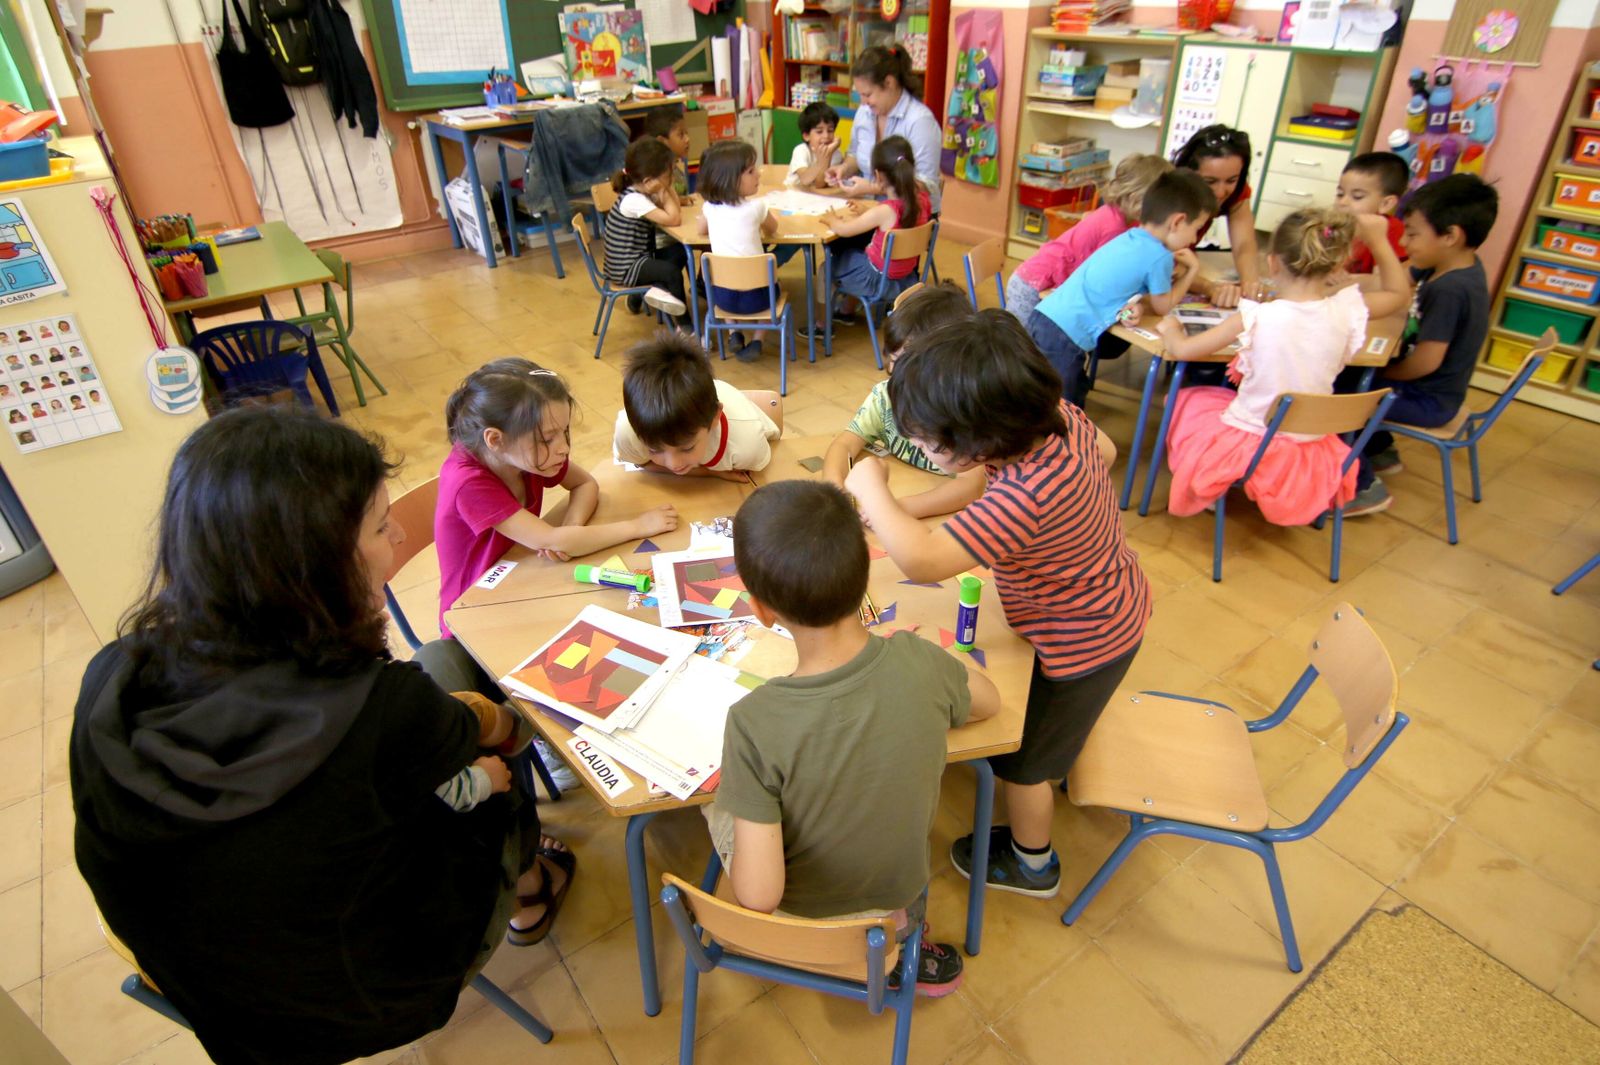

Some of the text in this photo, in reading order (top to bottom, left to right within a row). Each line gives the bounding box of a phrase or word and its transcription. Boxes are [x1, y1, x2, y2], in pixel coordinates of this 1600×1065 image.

[6, 292, 36, 304] CASITA
[484, 565, 508, 583] MAR
[575, 740, 619, 790] CLAUDIA
